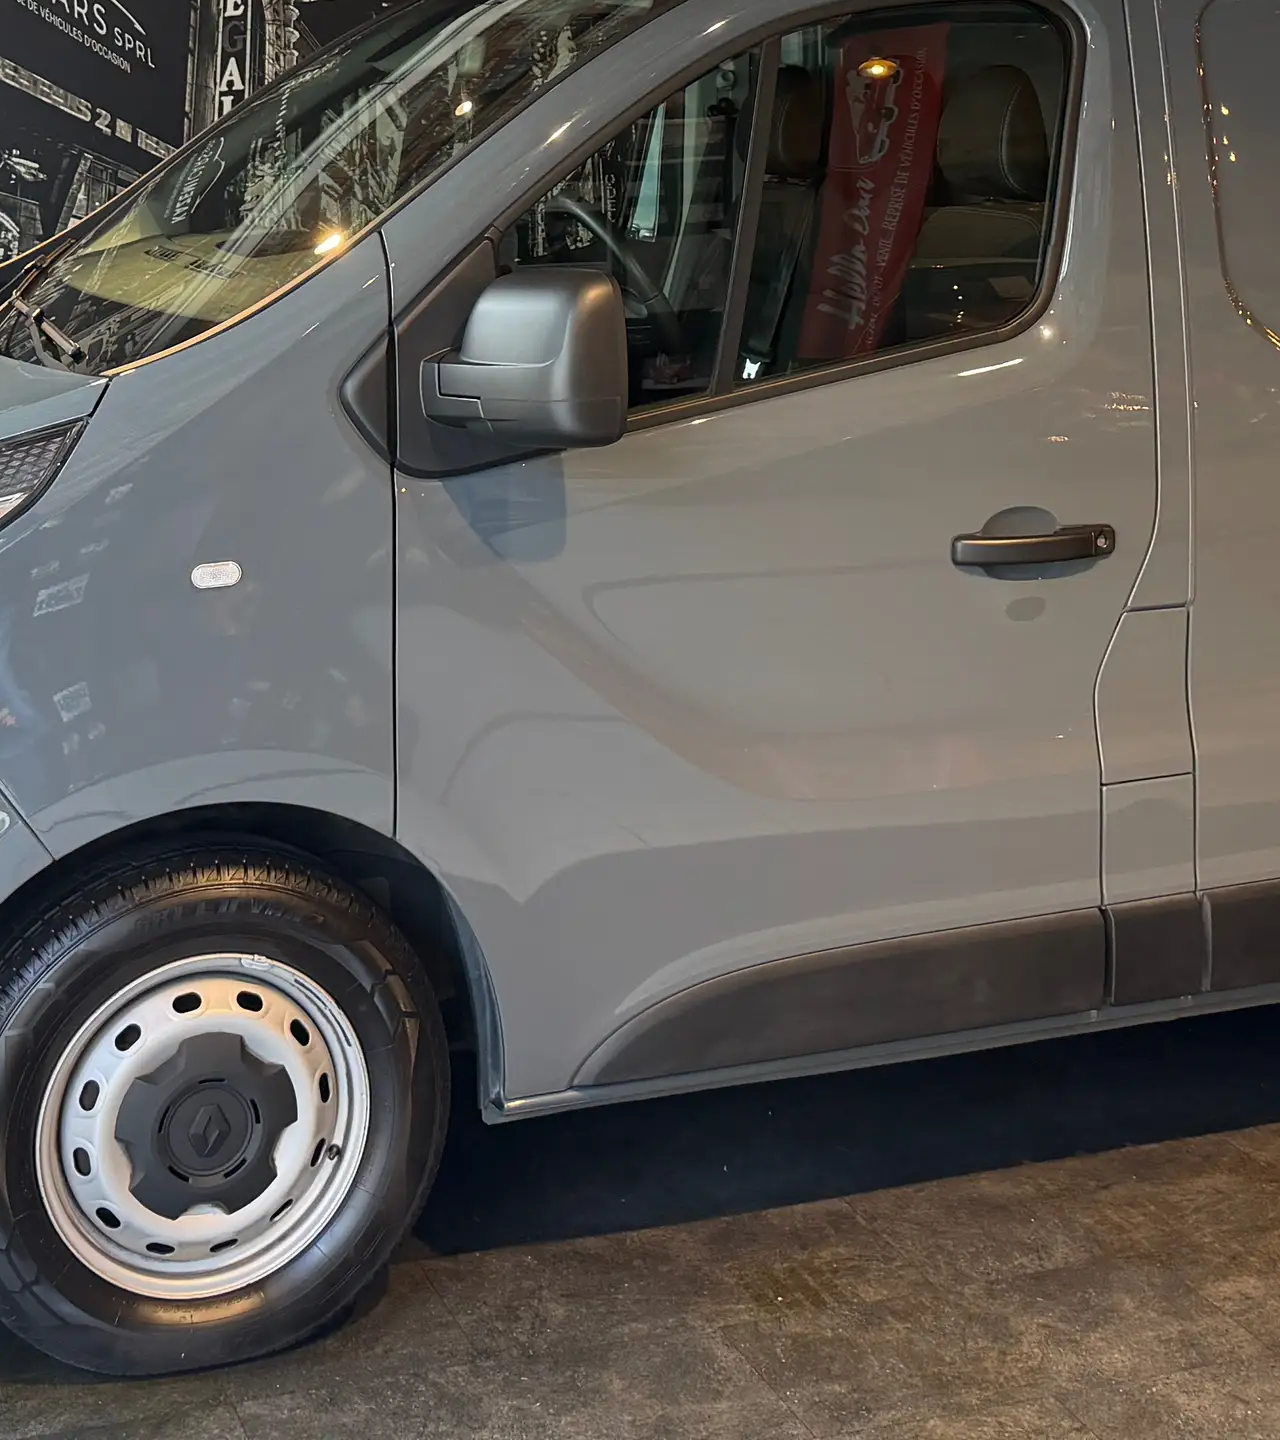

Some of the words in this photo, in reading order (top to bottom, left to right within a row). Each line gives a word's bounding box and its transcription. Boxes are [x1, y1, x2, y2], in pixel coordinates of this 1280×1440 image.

[40, 6, 83, 43] VÉHICULES
[84, 33, 131, 74] D'OCCASION
[114, 26, 156, 68] SPRL
